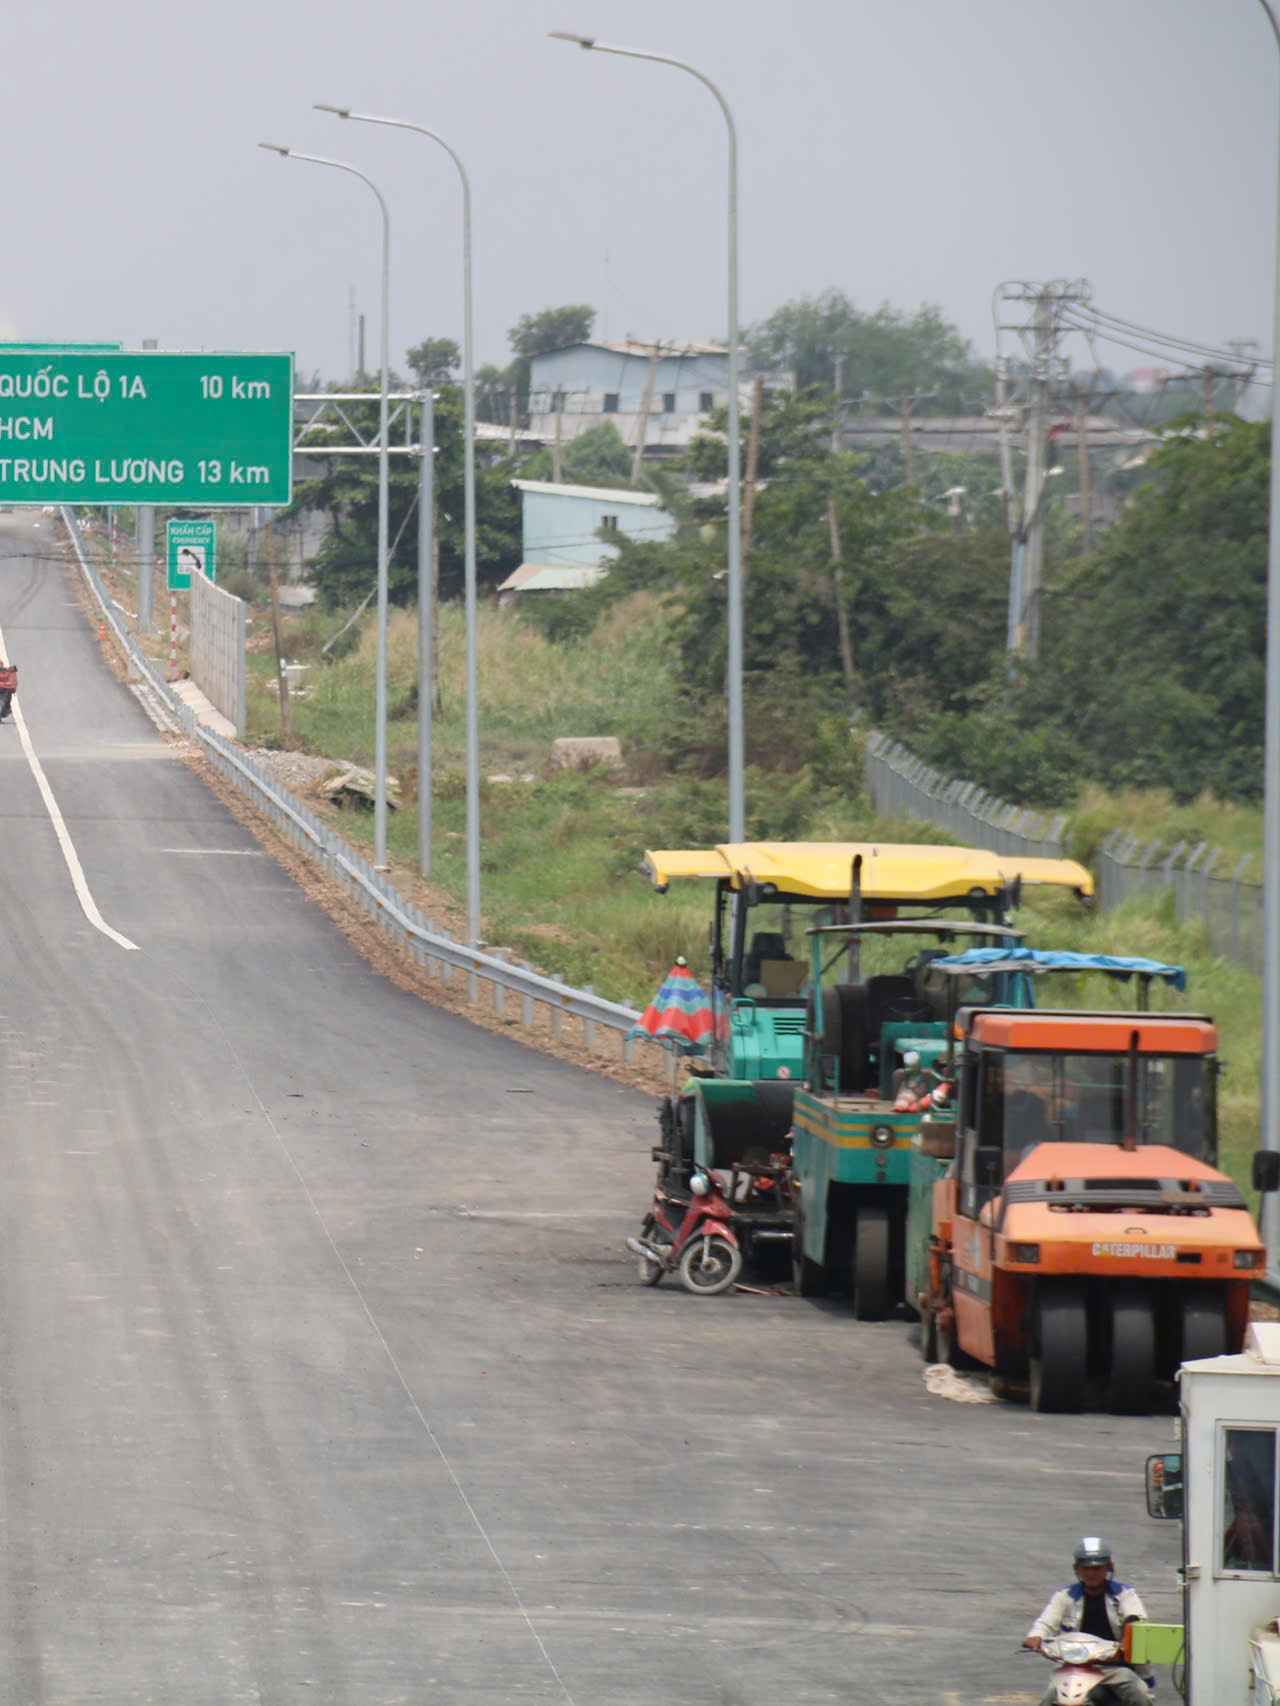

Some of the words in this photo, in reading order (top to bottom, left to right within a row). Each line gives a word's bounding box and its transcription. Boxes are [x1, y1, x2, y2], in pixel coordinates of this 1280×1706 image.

[77, 369, 111, 402] LỘ
[119, 375, 147, 399] 1A
[200, 375, 223, 399] 10
[232, 376, 271, 399] km
[95, 457, 184, 483] LƯƠNG
[197, 461, 221, 484] 13
[229, 461, 270, 484] km
[1092, 1242, 1177, 1259] CATERPILLAR
